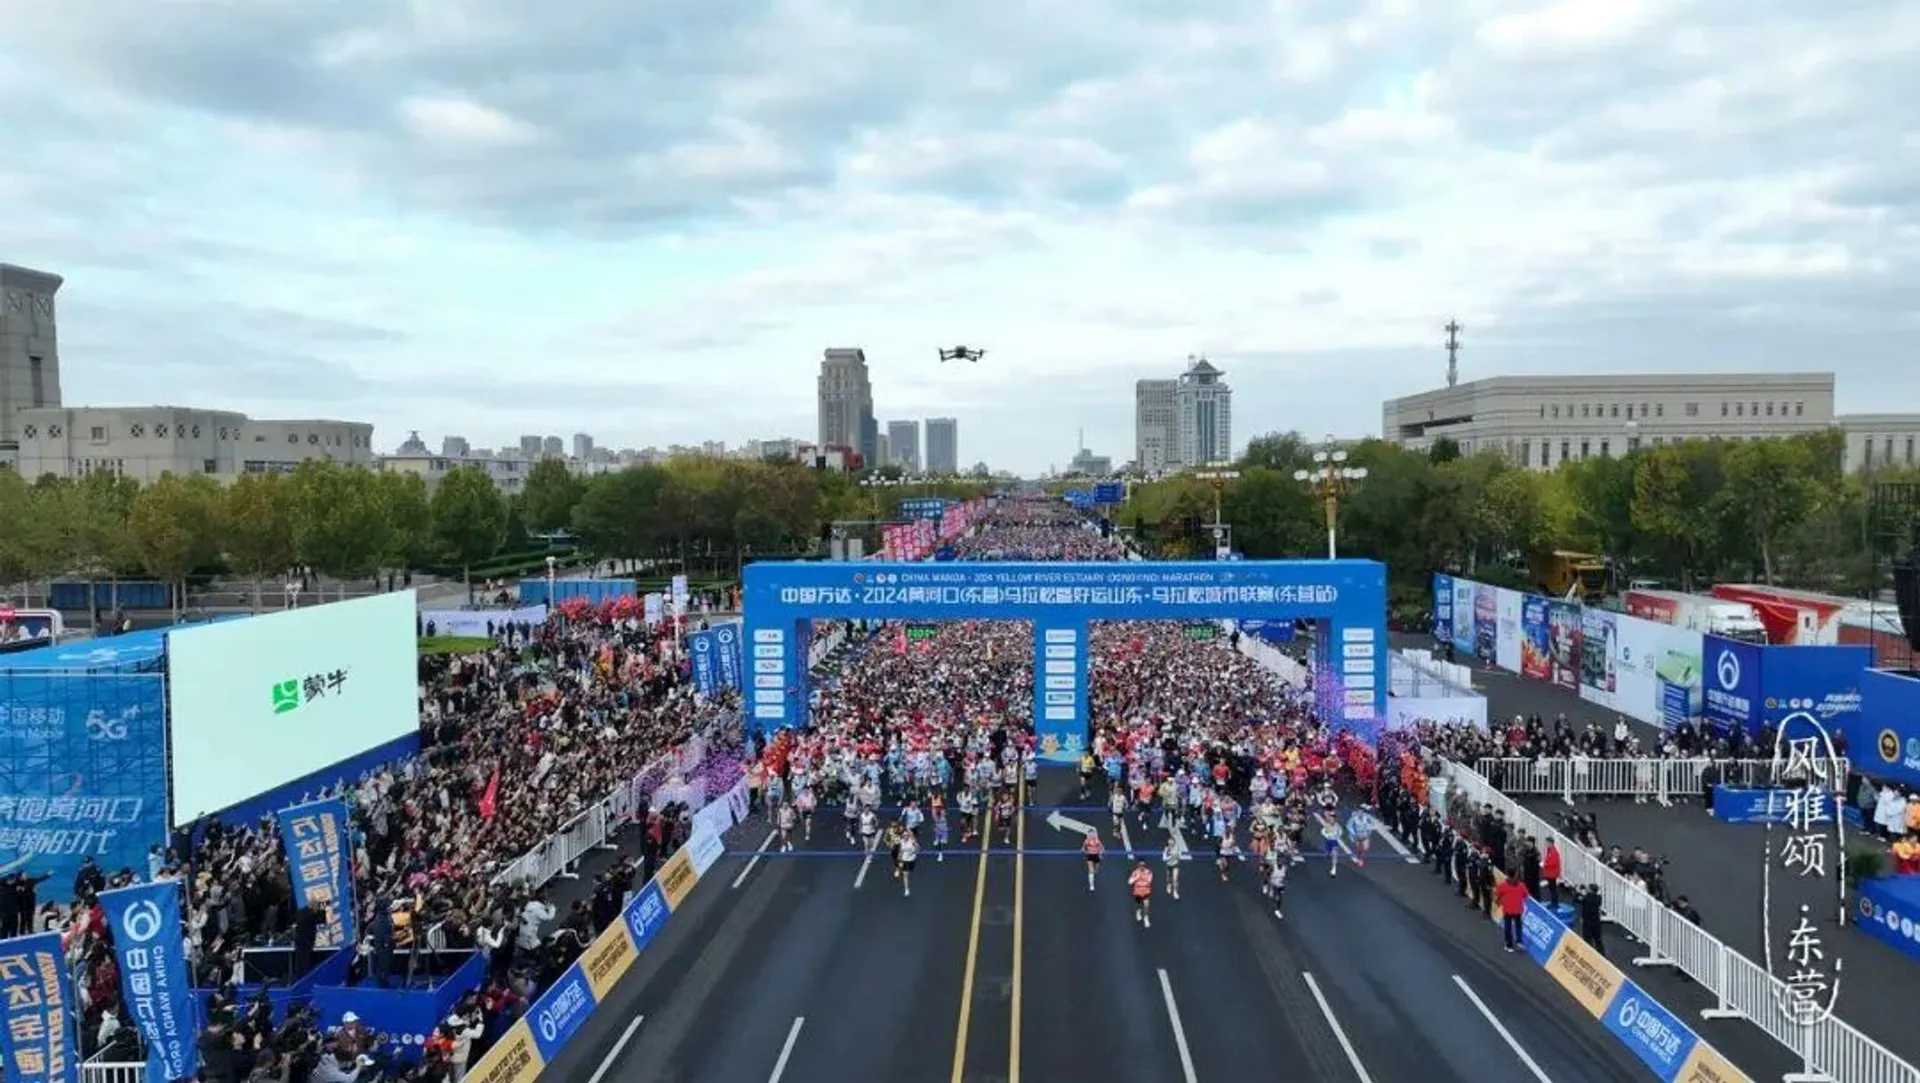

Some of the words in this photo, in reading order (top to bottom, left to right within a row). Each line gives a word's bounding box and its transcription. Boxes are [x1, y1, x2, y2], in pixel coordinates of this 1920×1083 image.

[932, 573, 965, 583] WANDA
[995, 573, 1033, 582] YELLOW
[1034, 573, 1062, 582] RIVER
[1063, 572, 1104, 582] ESTUARY
[1162, 572, 1214, 582] MARATHON
[302, 667, 347, 703] 蒙牛
[1636, 1009, 1682, 1057] 中国万达
